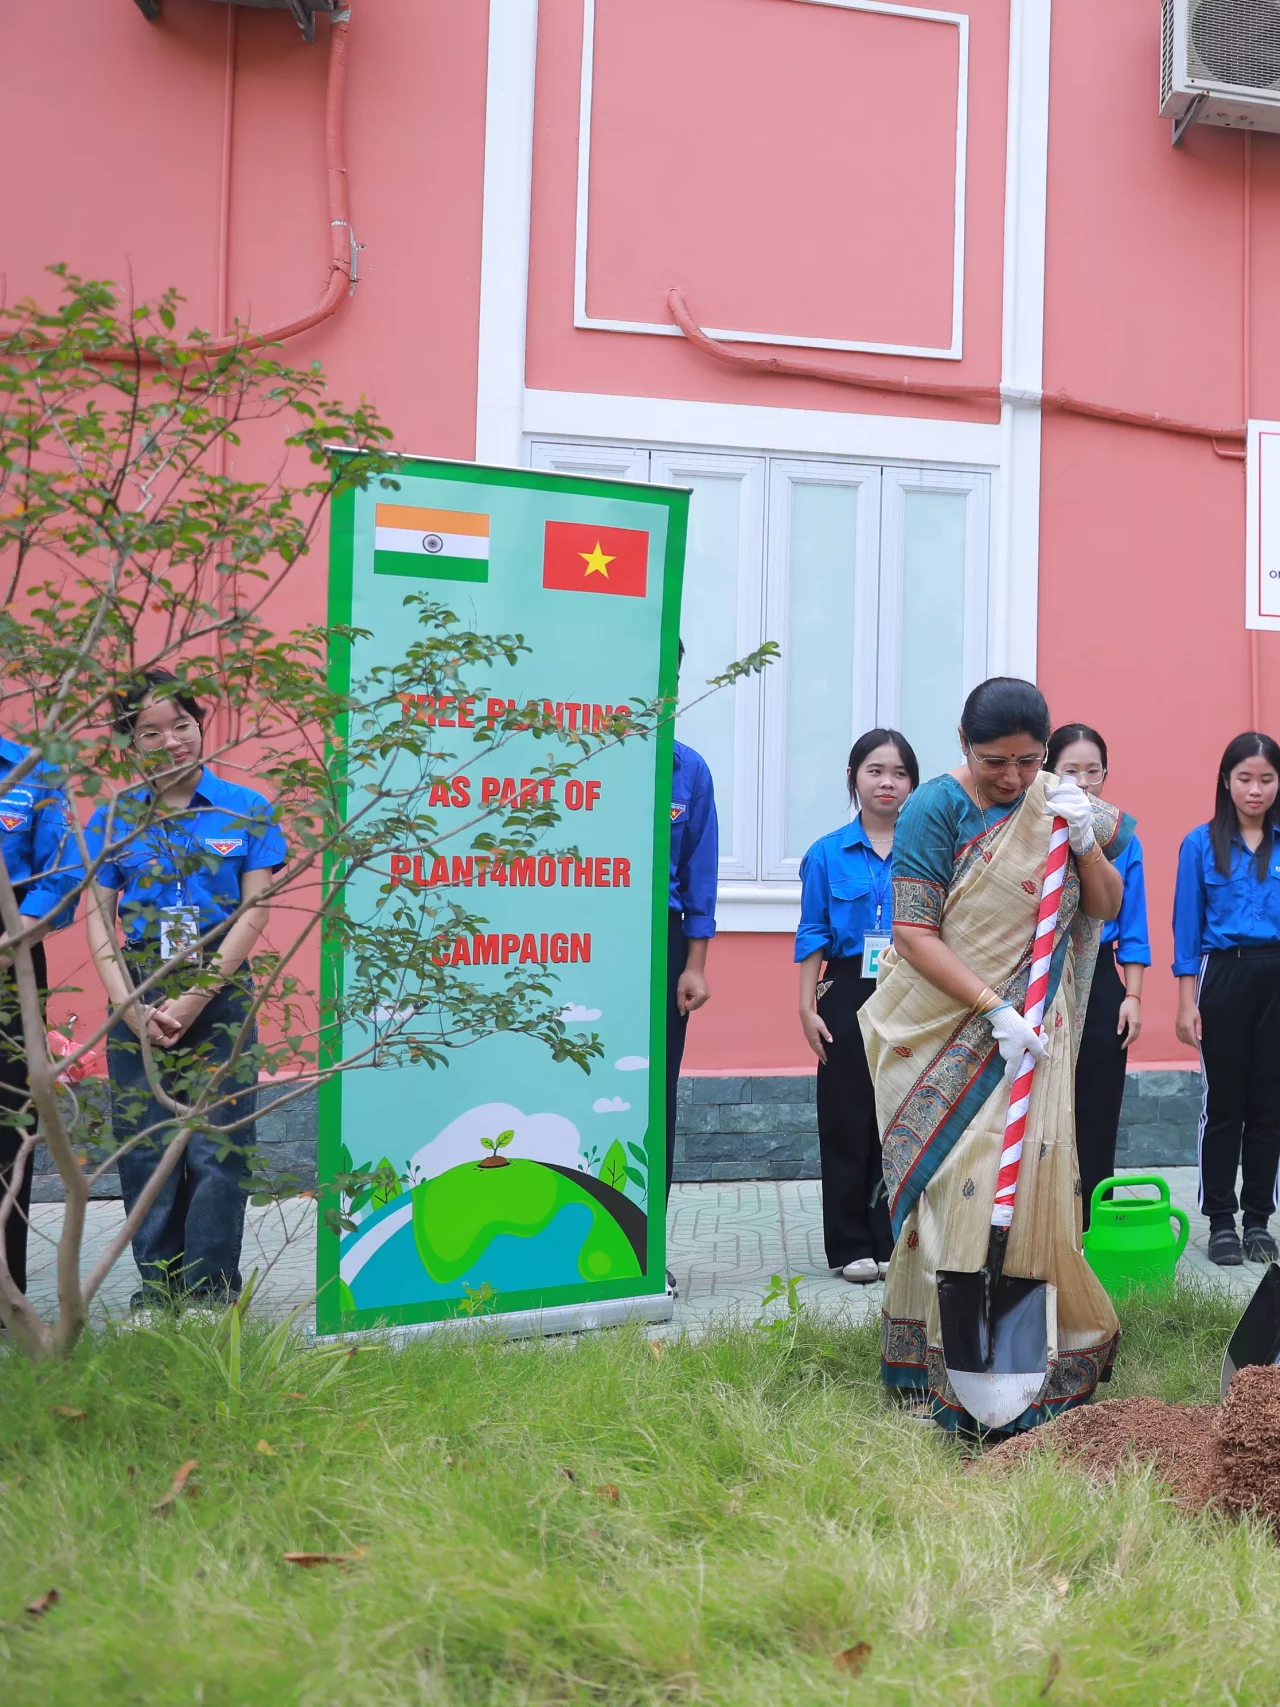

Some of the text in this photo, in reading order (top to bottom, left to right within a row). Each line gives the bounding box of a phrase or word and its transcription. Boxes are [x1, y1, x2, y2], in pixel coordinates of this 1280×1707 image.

[486, 698, 632, 735] PLNTIN
[428, 776, 602, 811] AS PART OF
[390, 855, 632, 888] PLANT4MOTHER
